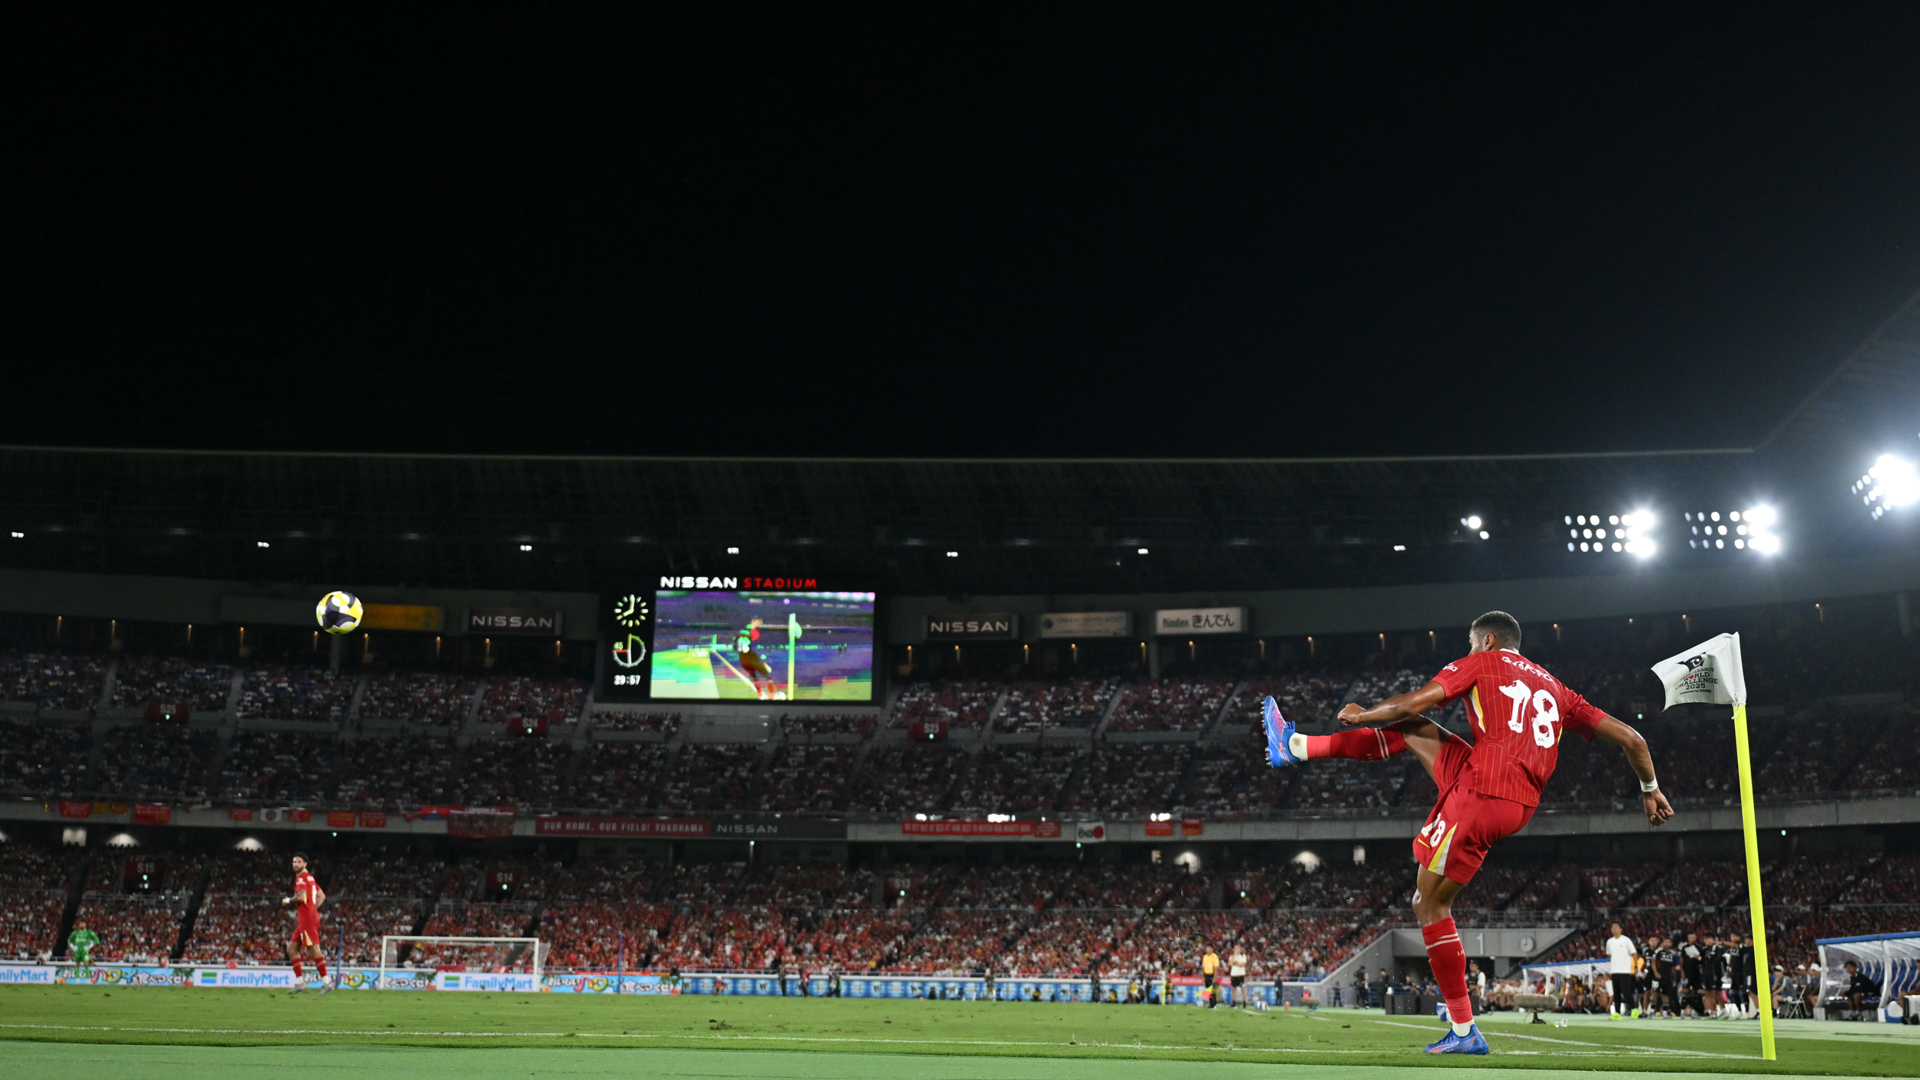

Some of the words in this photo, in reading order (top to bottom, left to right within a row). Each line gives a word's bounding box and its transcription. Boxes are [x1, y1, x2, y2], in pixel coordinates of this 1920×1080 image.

[660, 576, 738, 588] NISSAN
[743, 578, 817, 589] STADIUM
[472, 615, 553, 628] NISSAN
[930, 621, 1009, 633] NISSAN
[1192, 614, 1235, 628] きんでん
[1498, 679, 1560, 748] 18
[544, 821, 562, 831] OUR
[599, 822, 617, 832] OUR
[655, 823, 704, 833] YOKOHAMA
[717, 824, 778, 834] NISSAN
[1421, 812, 1446, 848] 18
[137, 863, 155, 874] S15
[497, 872, 513, 883] S14
[894, 878, 911, 889] S13
[1591, 875, 1609, 888] S11
[1234, 879, 1251, 891] S12
[1476, 932, 1484, 955] 1
[221, 972, 289, 986] FamilyMart
[465, 976, 534, 990] FamilyMart
